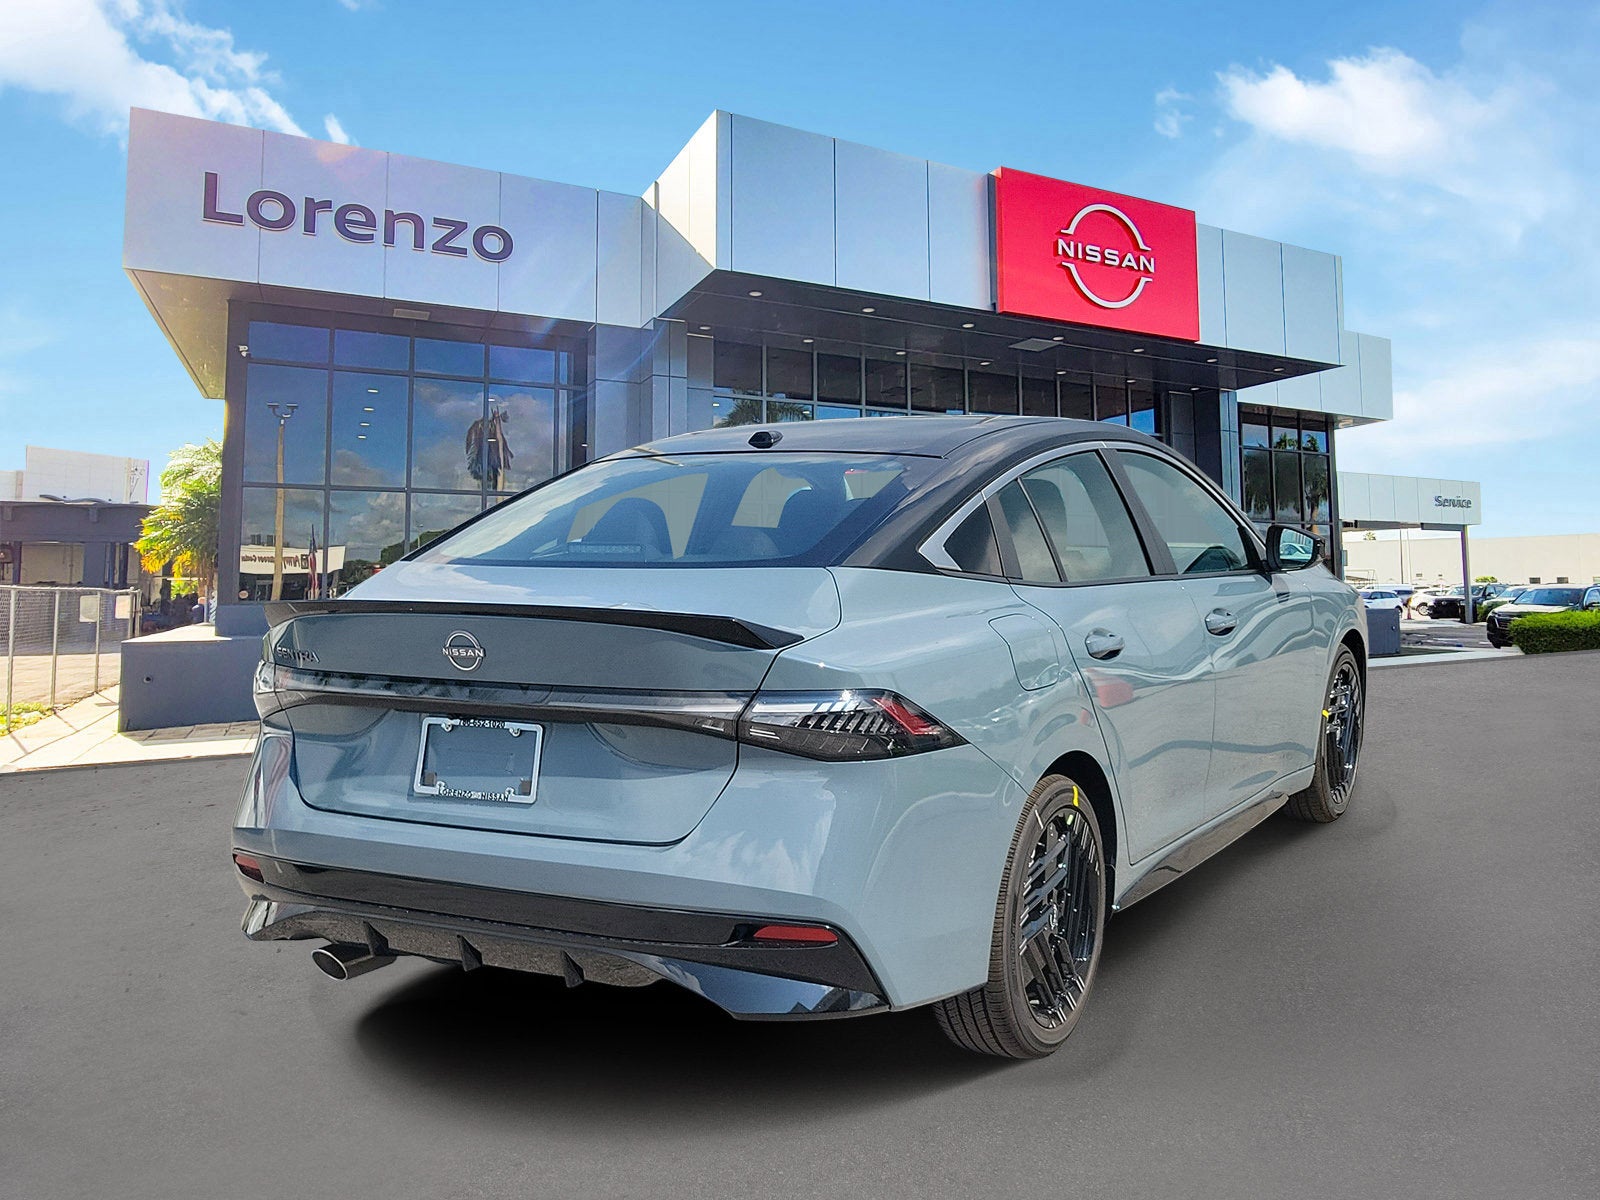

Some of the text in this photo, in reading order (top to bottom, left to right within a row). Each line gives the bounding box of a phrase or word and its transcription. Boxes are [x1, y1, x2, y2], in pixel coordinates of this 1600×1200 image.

[202, 171, 514, 262] Lorenzo
[1057, 238, 1155, 273] NISSAN
[1434, 495, 1472, 509] Service
[276, 646, 320, 663] SENTRA
[442, 647, 484, 657] NISSAN
[438, 787, 509, 802] LORENZO NISSAN
